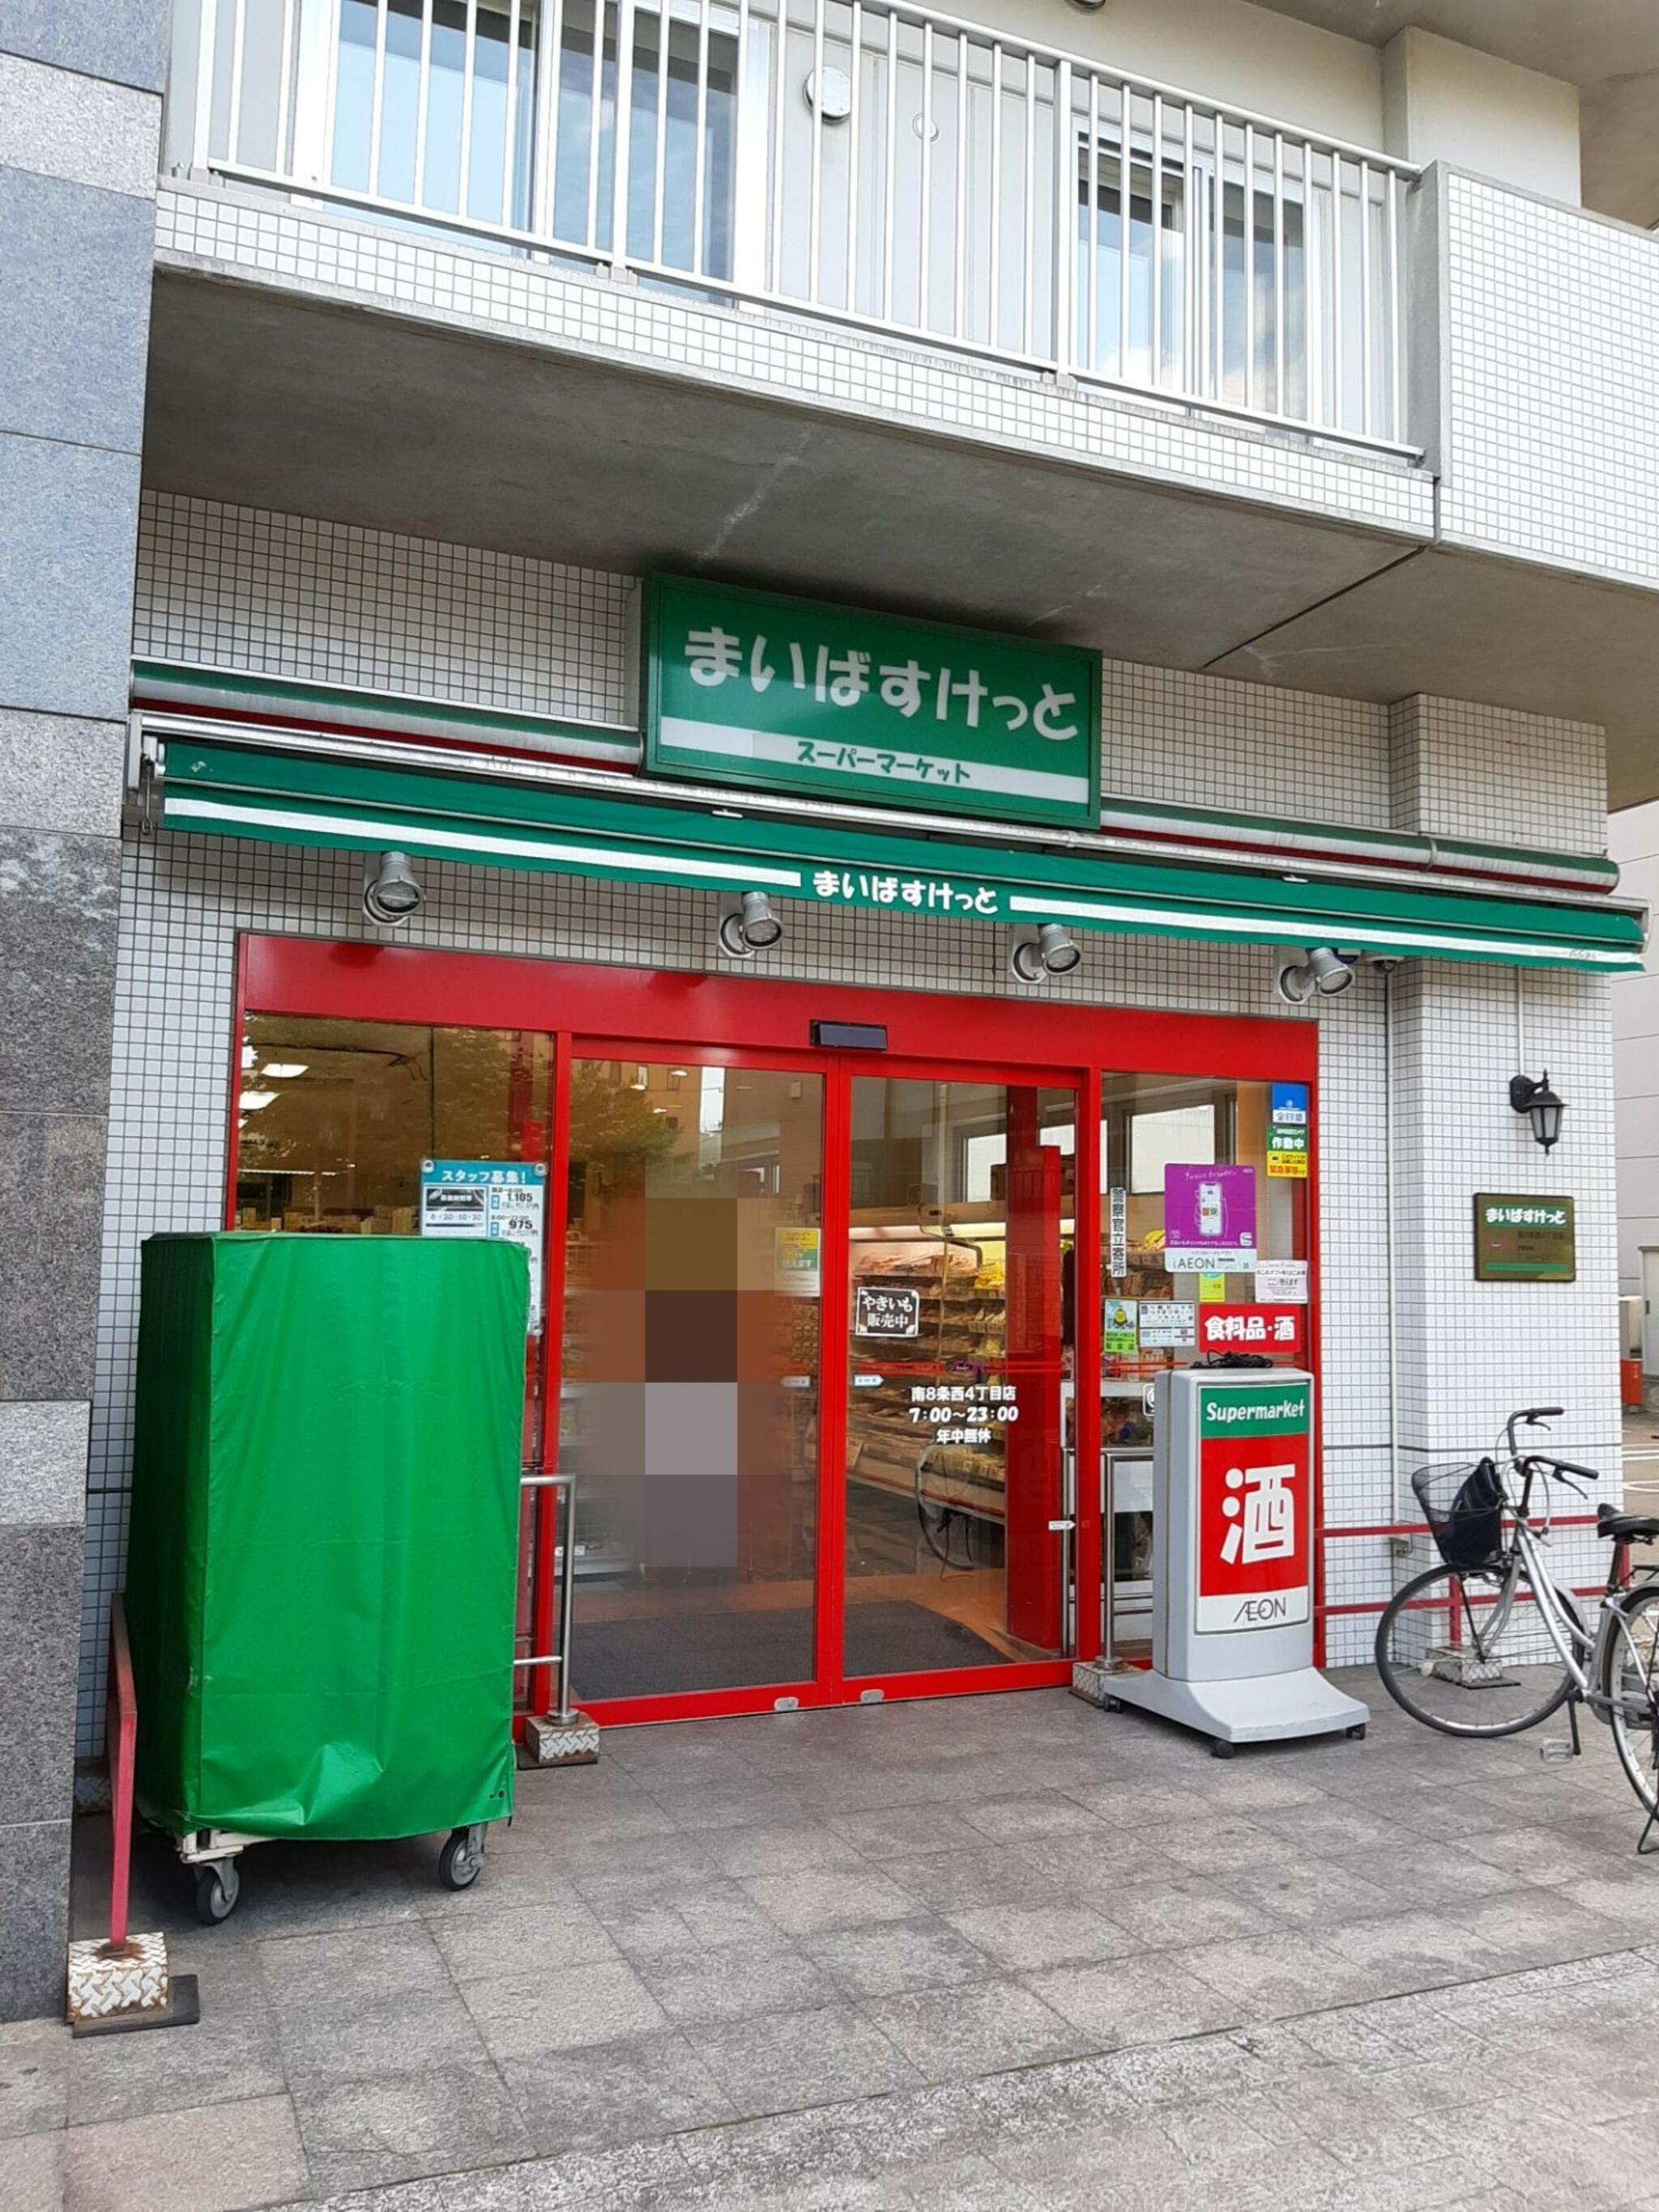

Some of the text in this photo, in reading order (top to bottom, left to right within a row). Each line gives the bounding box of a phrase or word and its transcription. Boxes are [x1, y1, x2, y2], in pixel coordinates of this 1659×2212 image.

[684, 626, 1079, 740] まいばすけっと
[796, 739, 971, 785] スーパーマーケット
[812, 870, 999, 914] まいばすけっと
[509, 1220, 533, 1230] 975
[1486, 1208, 1567, 1224] まいばすけっと
[1112, 1188, 1124, 1275] 警察官立寄所
[862, 1295, 913, 1312] やきいも
[867, 1312, 909, 1328] 販売中
[1205, 1315, 1295, 1340] 食料品・酒
[911, 1386, 1017, 1402] 南8条西4丁目店
[1206, 1399, 1305, 1423] Supermarket
[936, 1428, 992, 1444] 年中無休
[1220, 1464, 1296, 1565] 酒
